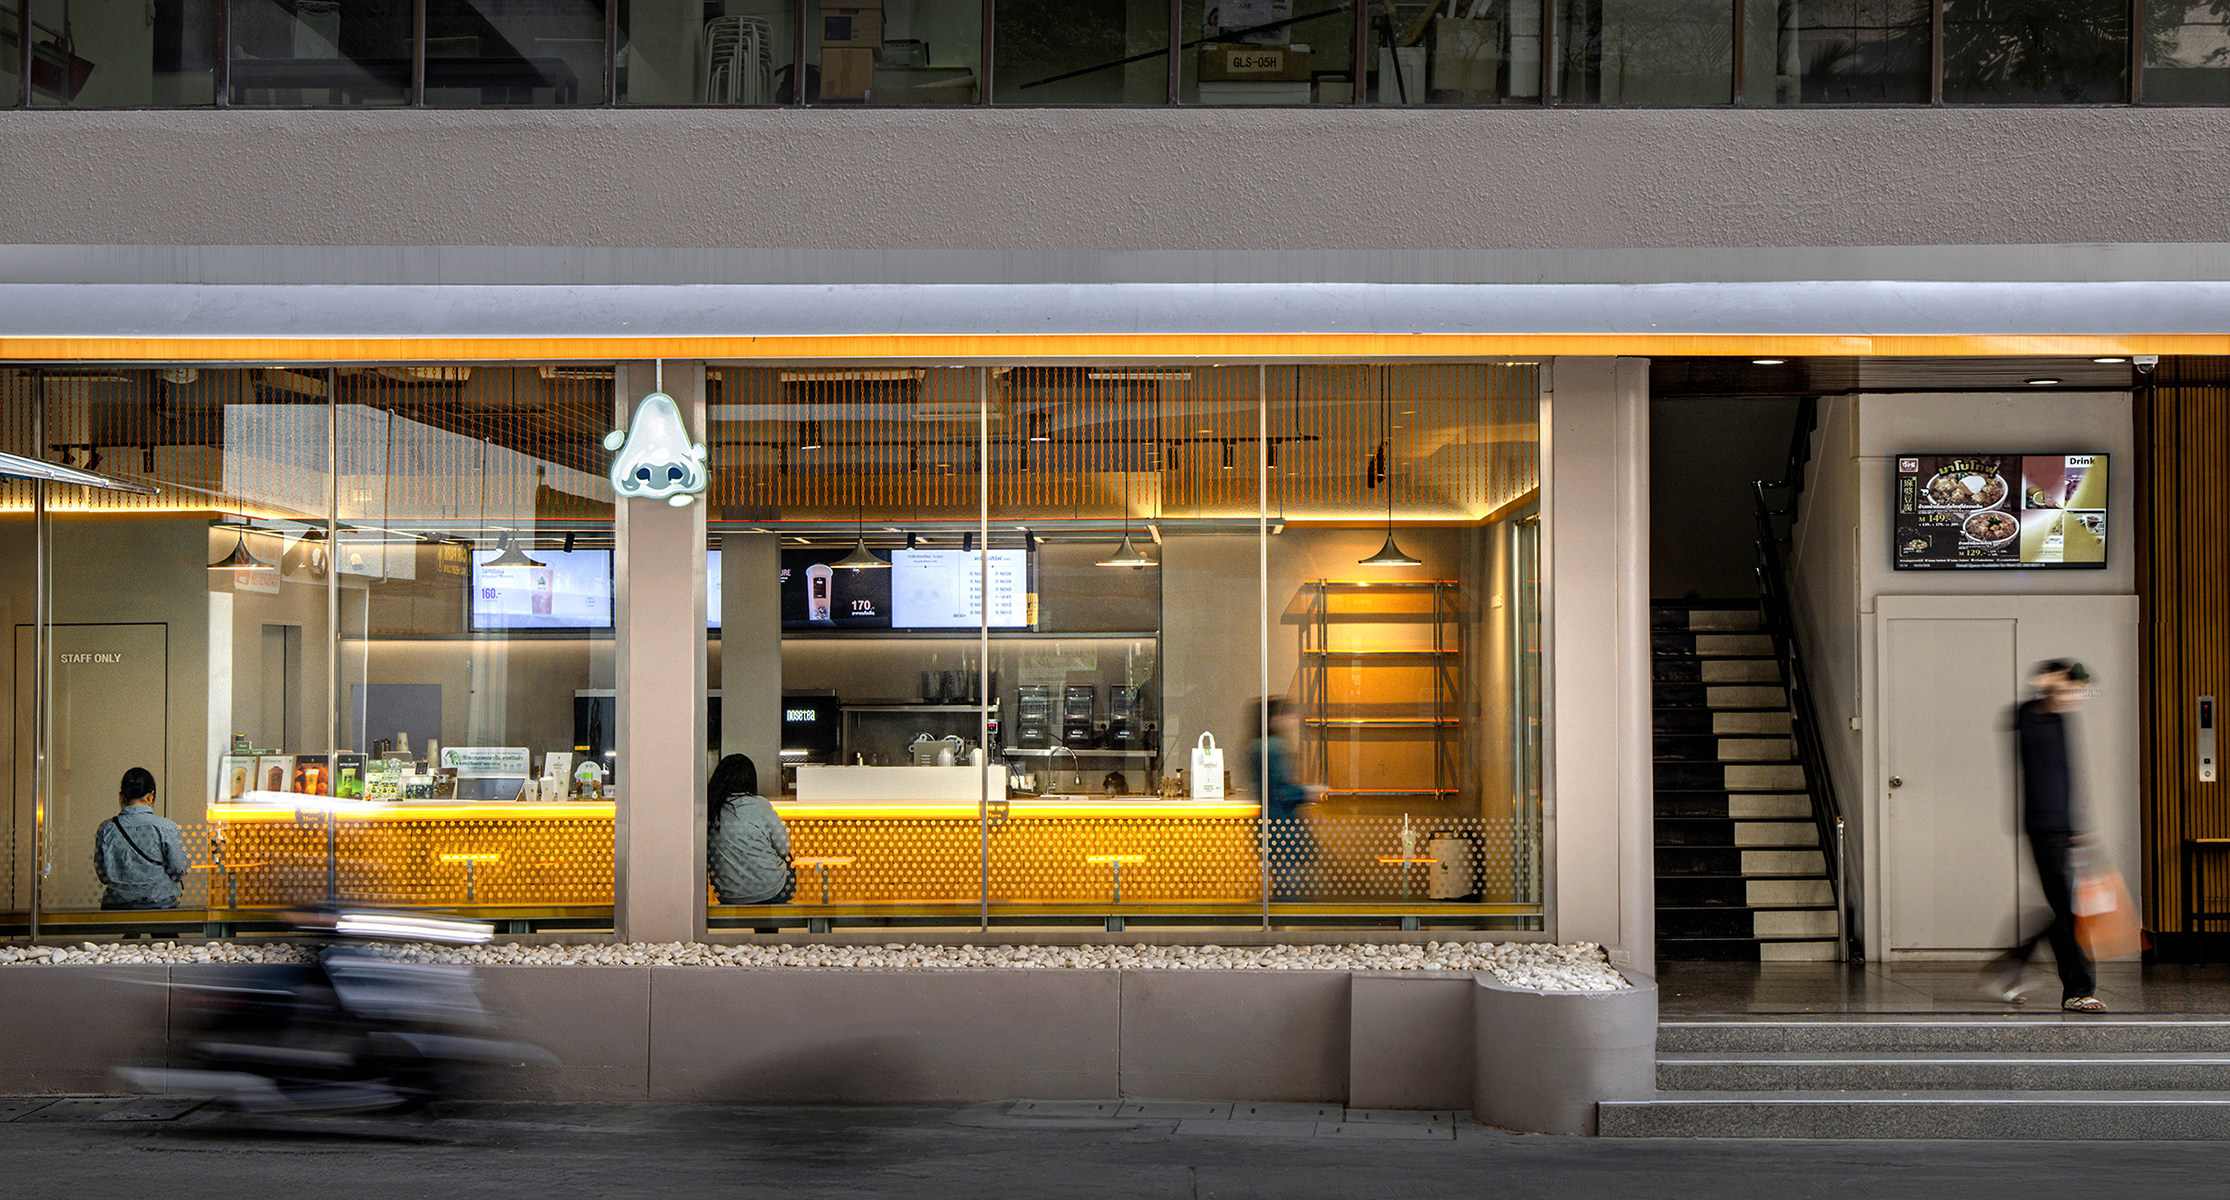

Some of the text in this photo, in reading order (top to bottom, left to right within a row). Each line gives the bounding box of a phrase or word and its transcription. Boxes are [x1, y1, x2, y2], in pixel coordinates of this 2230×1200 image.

[1233, 57, 1277, 68] GLS-05H
[2069, 457, 2096, 465] Drink
[481, 588, 502, 599] 160.-
[60, 653, 121, 663] STAFF ONLY
